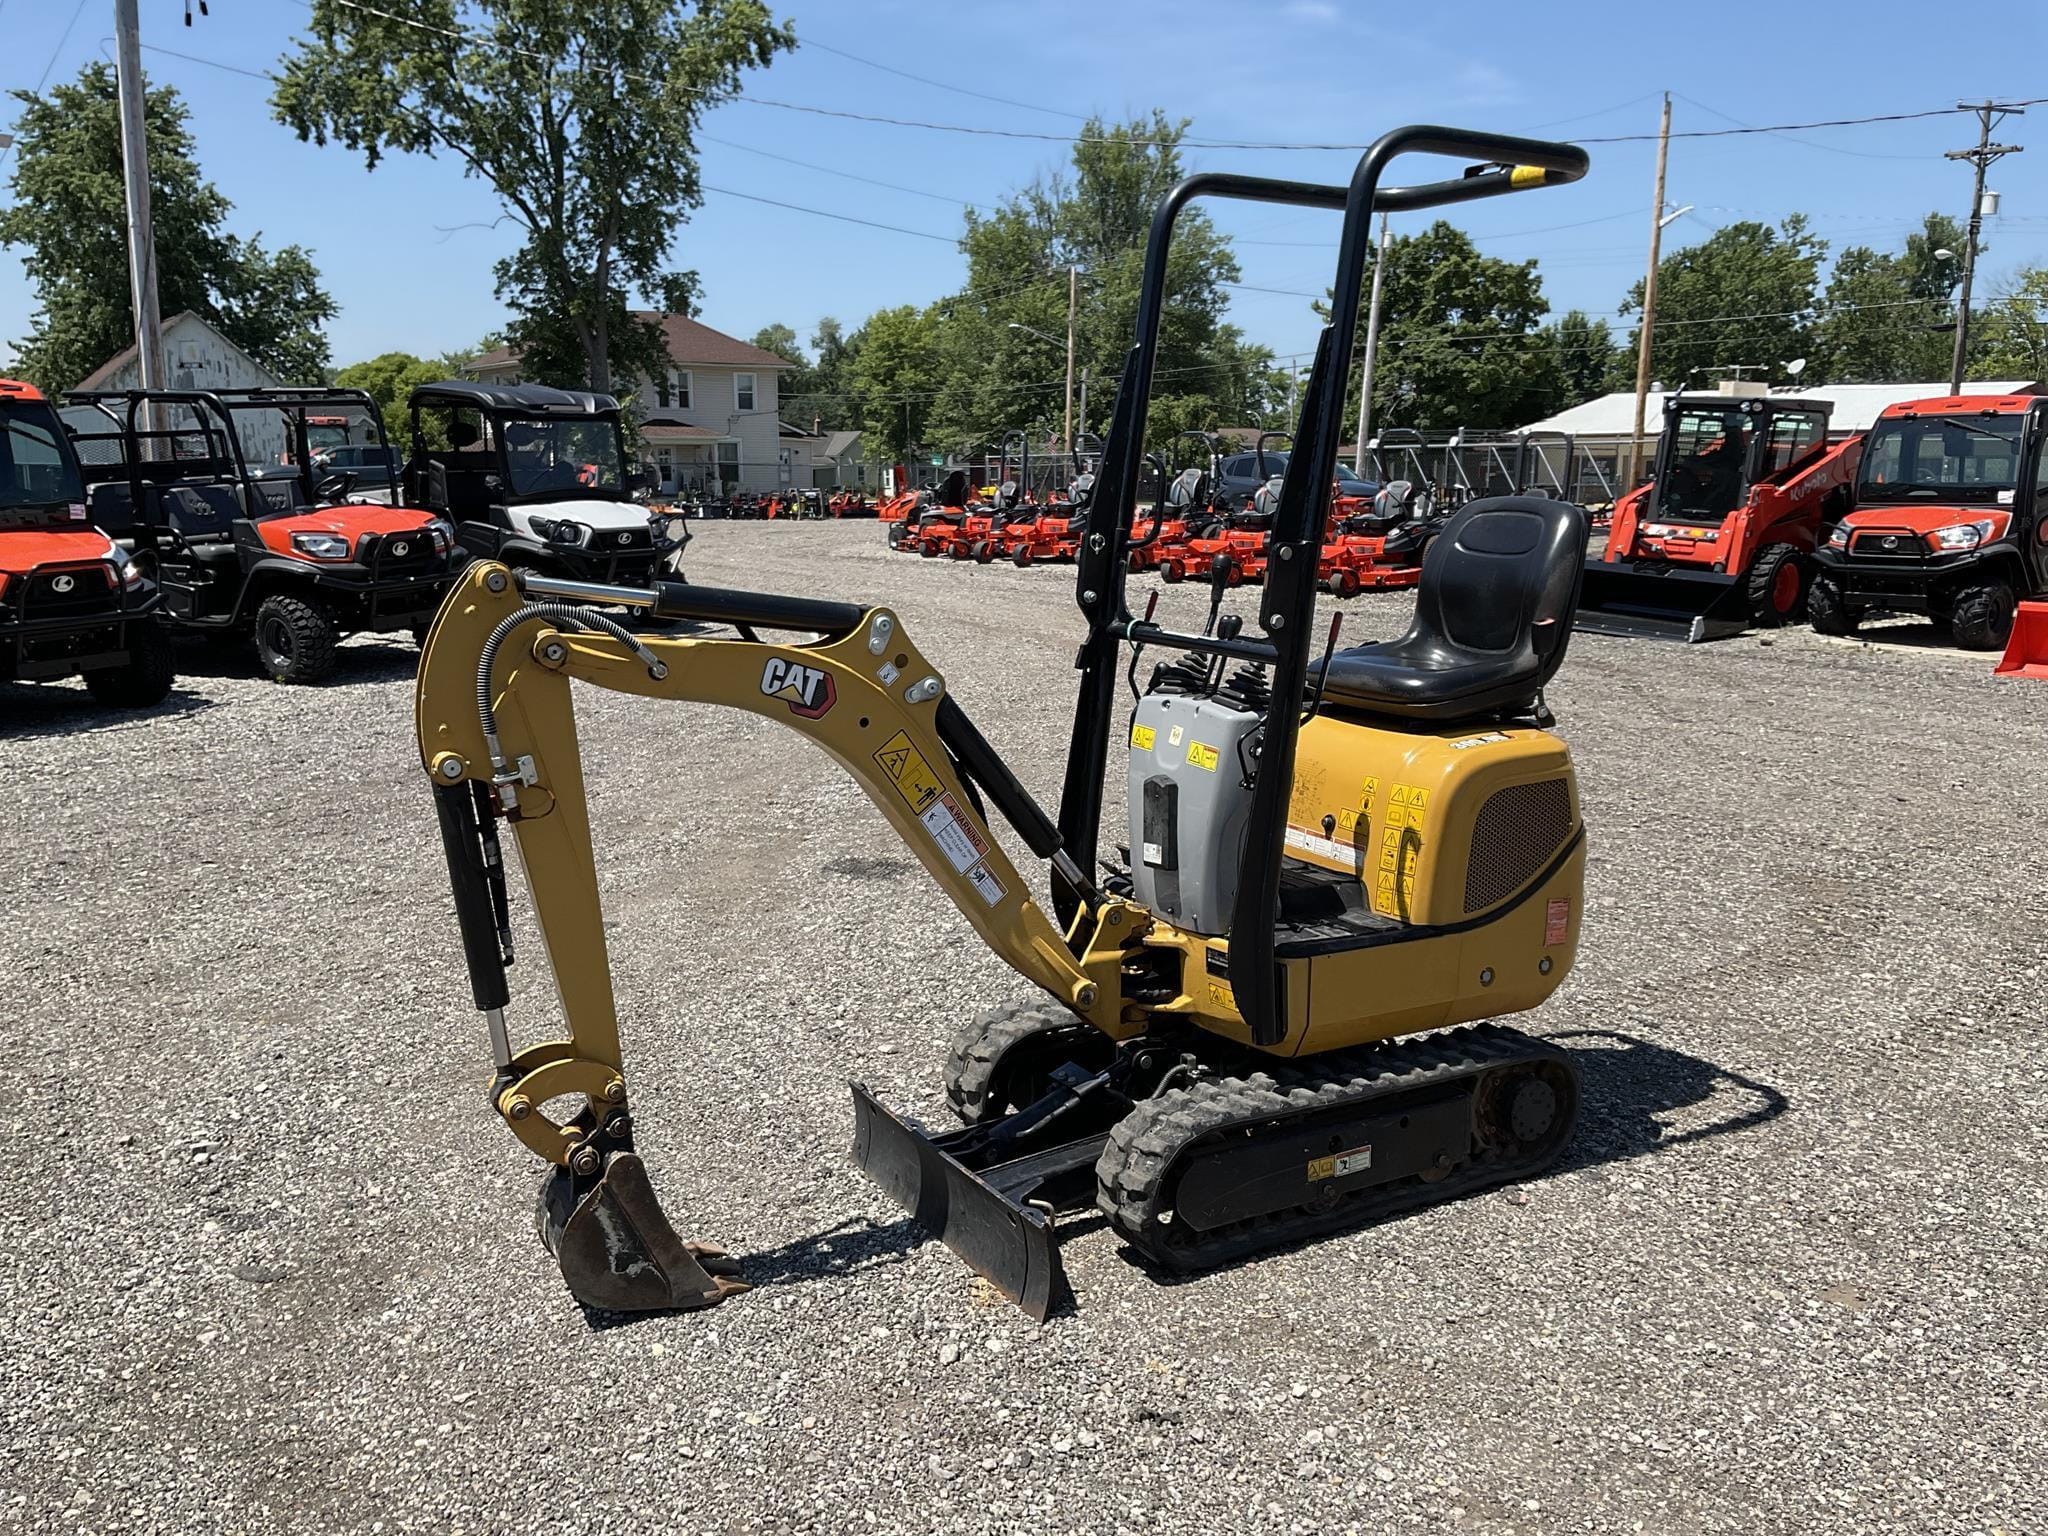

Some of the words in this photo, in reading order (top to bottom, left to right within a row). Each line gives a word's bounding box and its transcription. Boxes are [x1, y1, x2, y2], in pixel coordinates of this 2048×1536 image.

[1790, 472, 1827, 501] Kubota
[761, 657, 825, 706] CAT
[953, 809, 982, 847] WARNING
